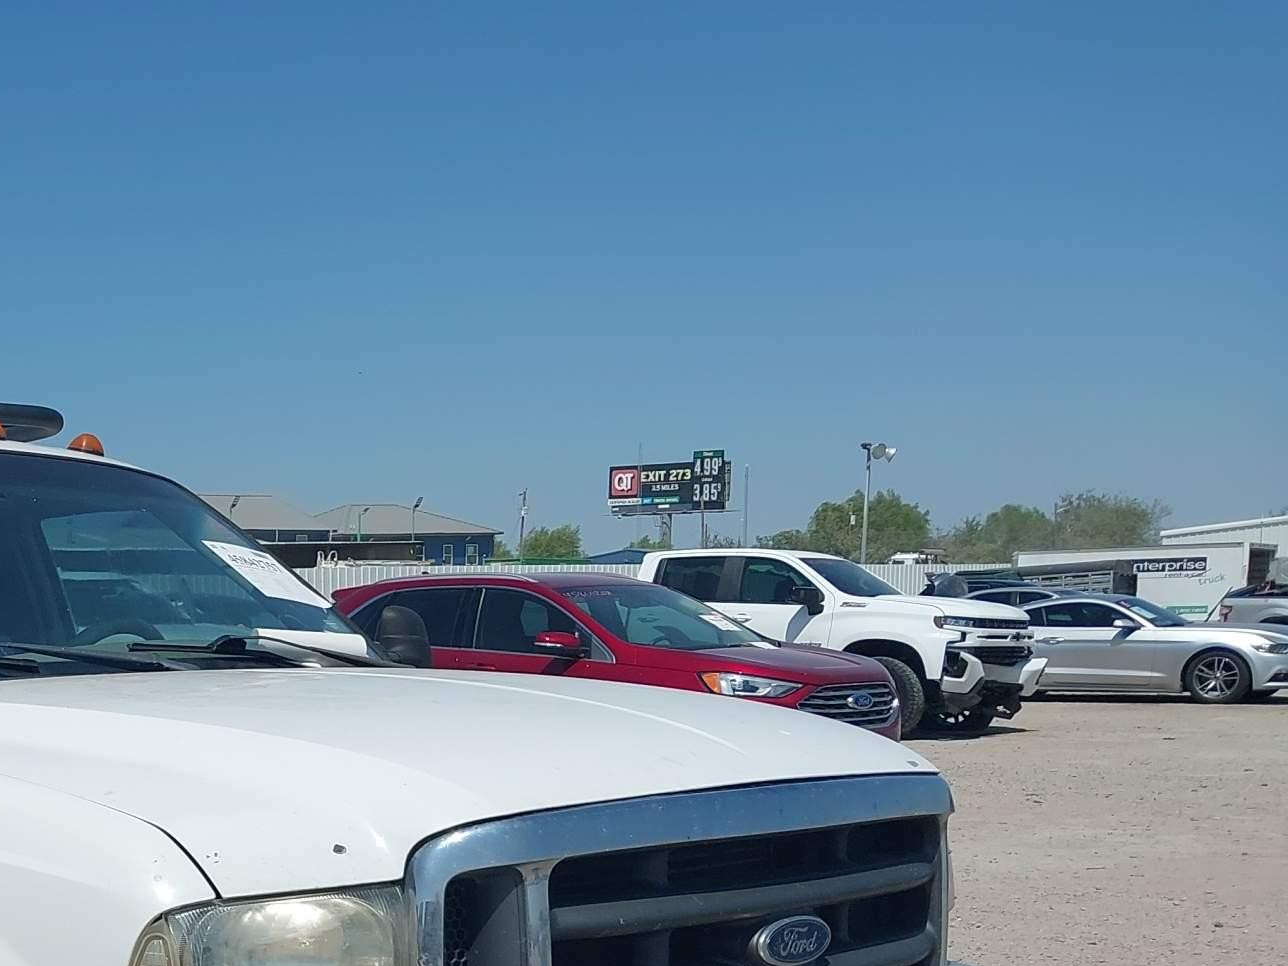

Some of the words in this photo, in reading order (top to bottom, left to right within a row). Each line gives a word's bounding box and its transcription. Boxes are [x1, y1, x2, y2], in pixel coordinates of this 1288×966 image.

[614, 473, 634, 493] QT
[641, 471, 666, 482] EXIT
[669, 469, 691, 481] 273
[1133, 558, 1205, 573] nterprise
[780, 926, 818, 957] Ford
